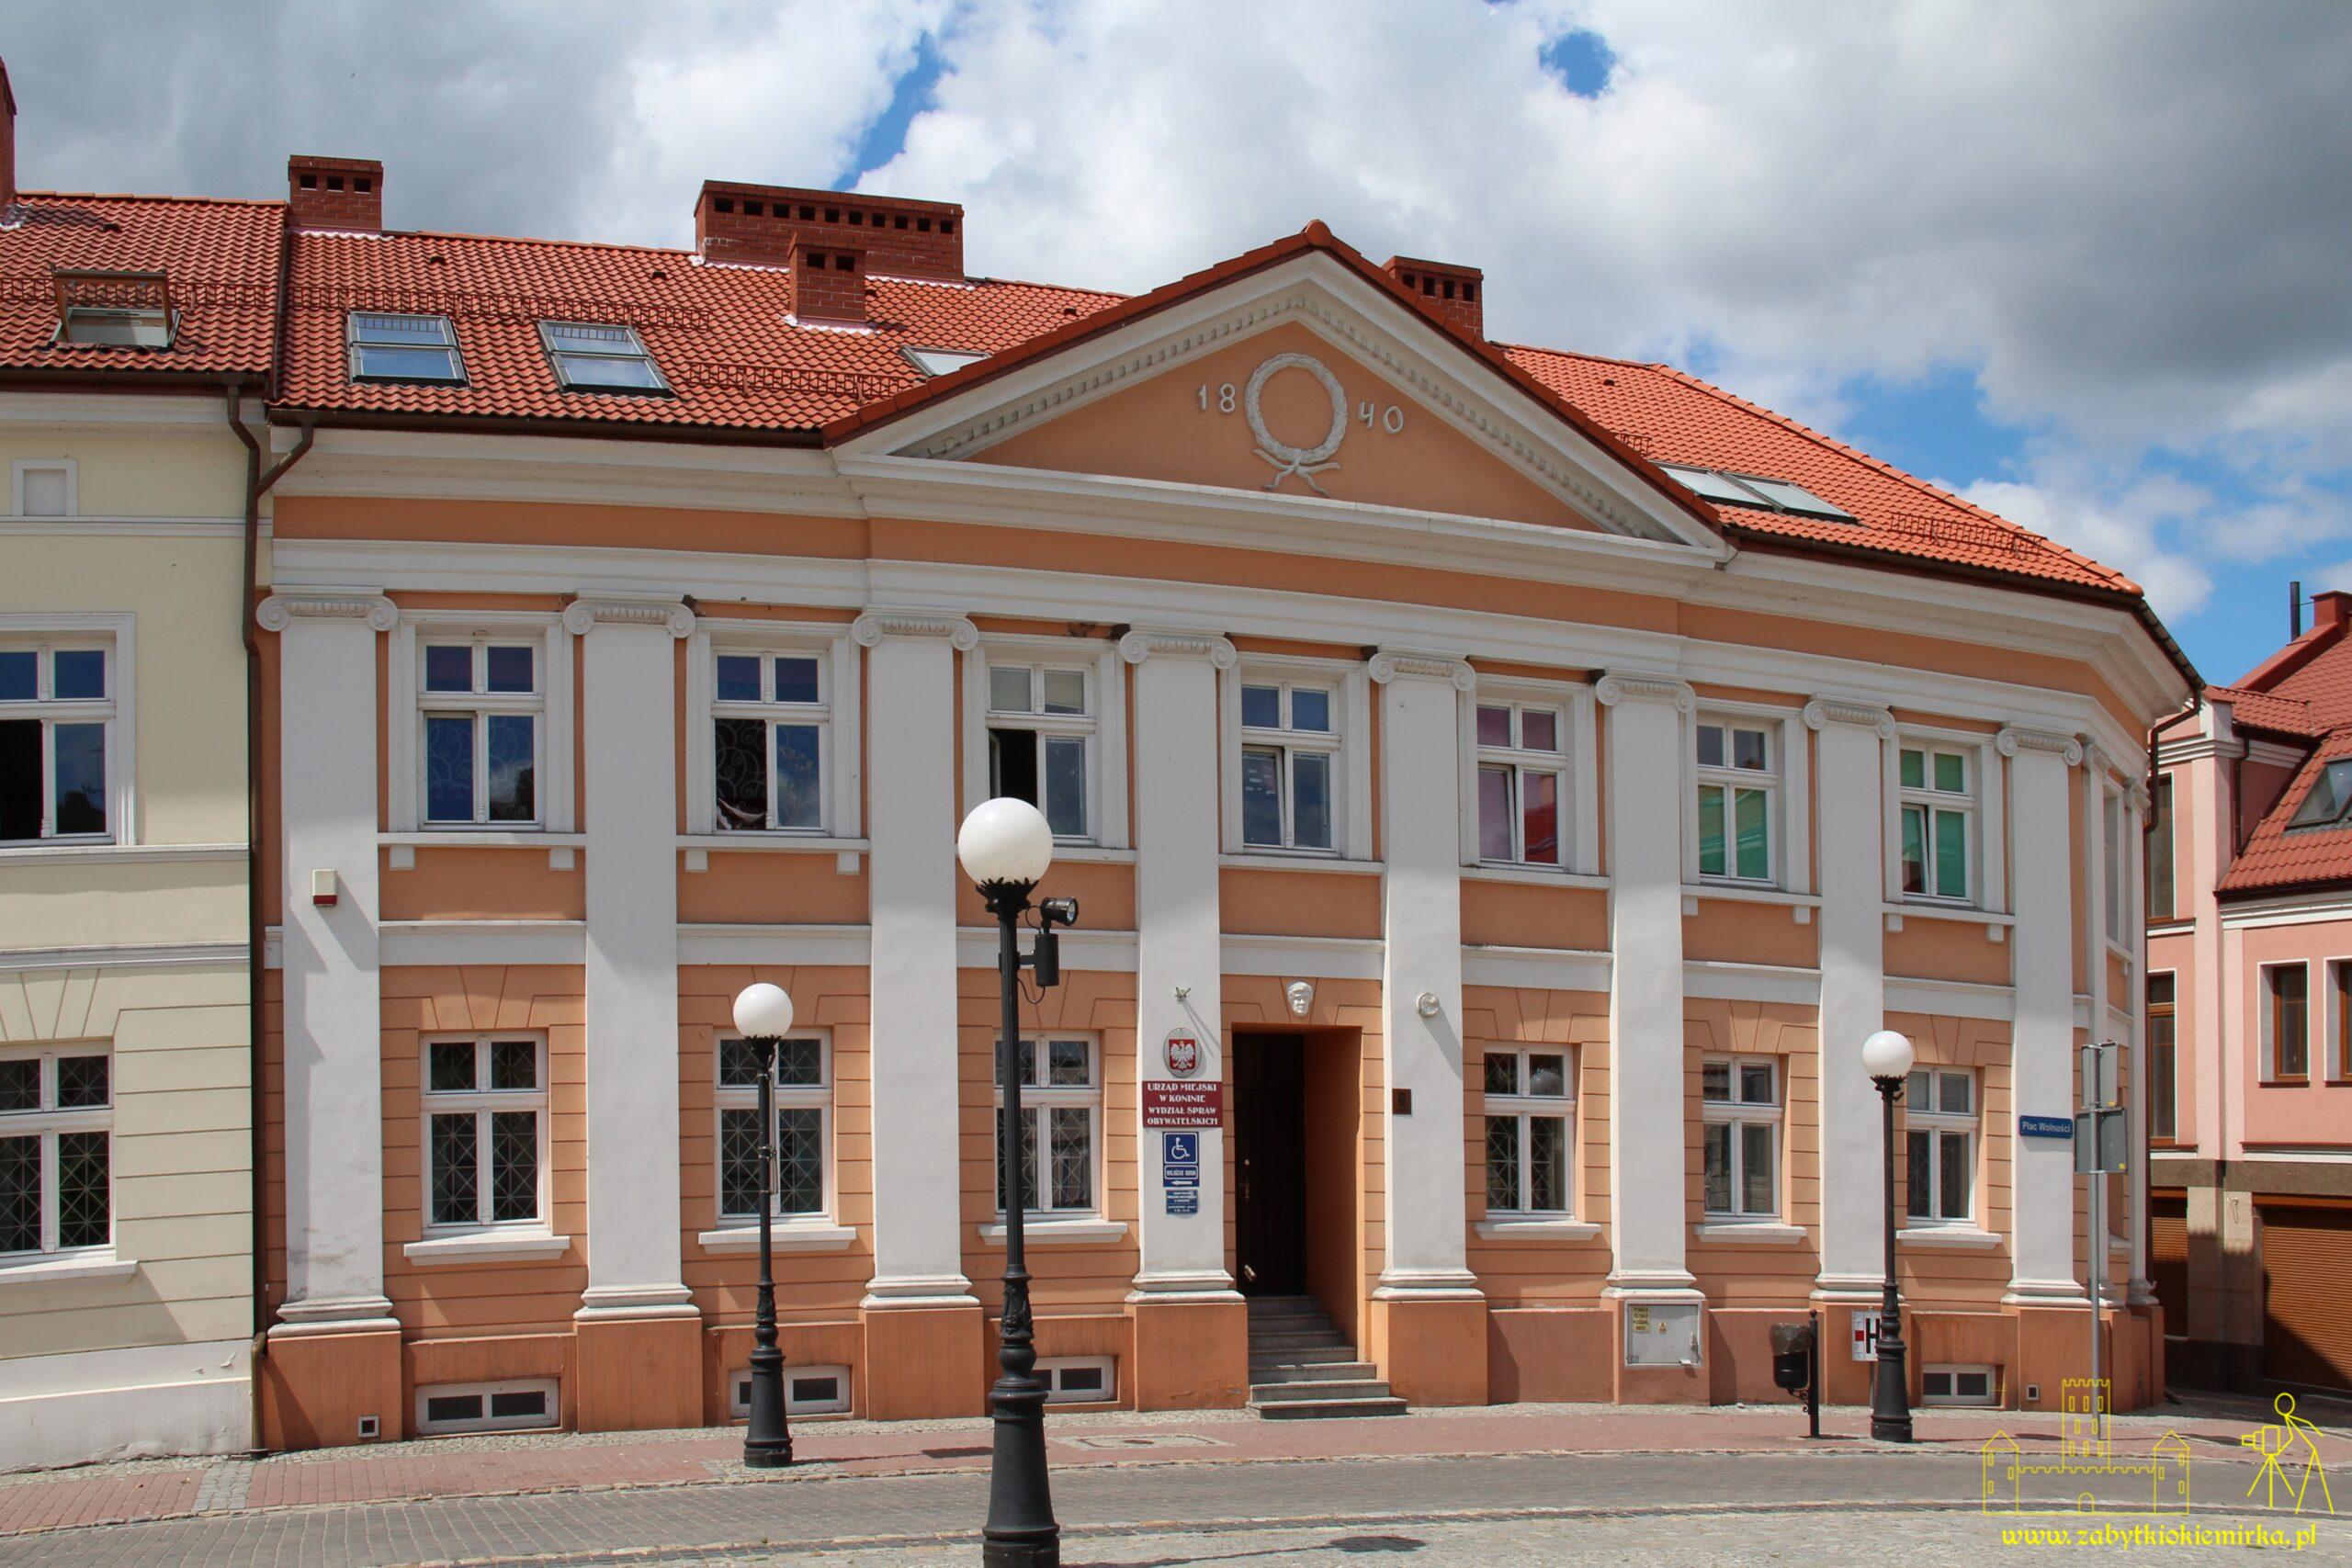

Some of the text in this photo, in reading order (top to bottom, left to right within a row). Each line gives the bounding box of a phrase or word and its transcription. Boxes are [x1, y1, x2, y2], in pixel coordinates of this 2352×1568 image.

[1198, 383, 1404, 434] 18 40
[1148, 1083, 1216, 1093] URZĄD MIEJSKI
[1147, 1117, 1218, 1125] OBYWATELSKICH
[2021, 1121, 2071, 1133] Plac Wolności
